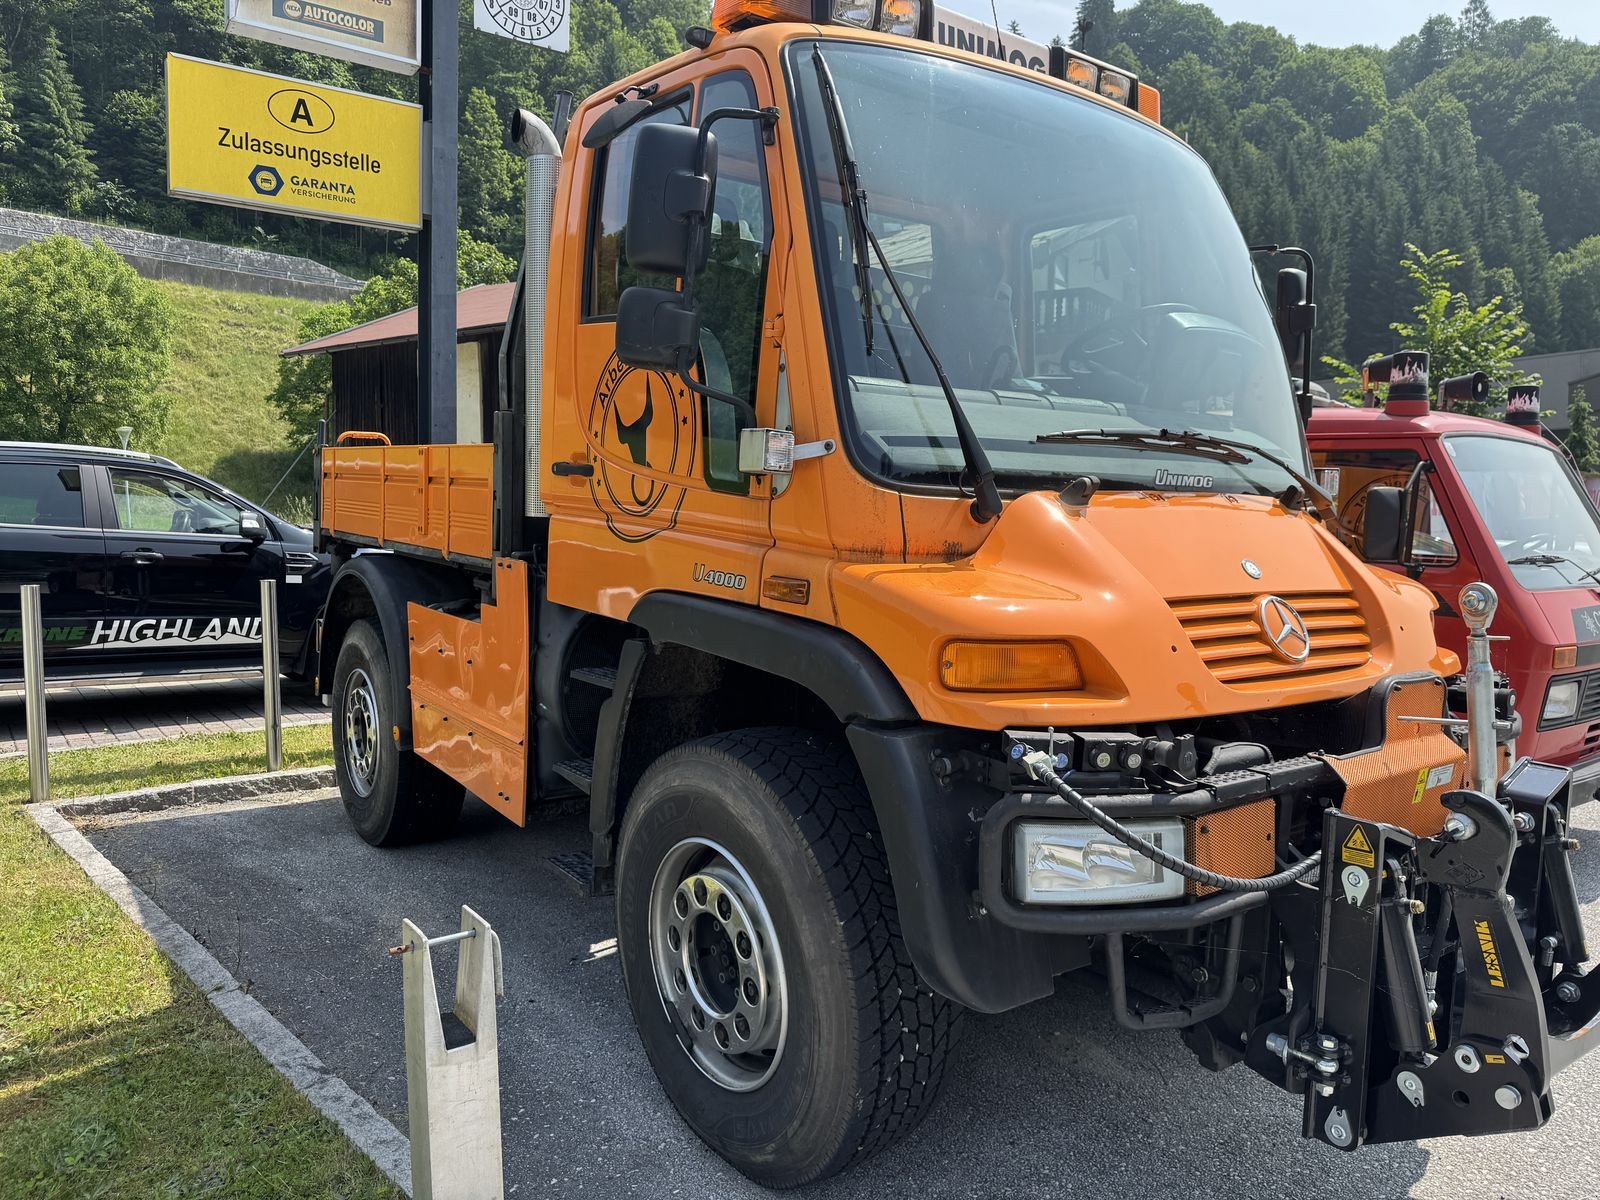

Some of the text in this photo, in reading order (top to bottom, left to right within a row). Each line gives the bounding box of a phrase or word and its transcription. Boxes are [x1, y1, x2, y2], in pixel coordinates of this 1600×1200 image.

[508, 6, 519, 18] 09
[538, 0, 548, 11] 07
[286, 4, 375, 33] NEXA AUTOCOLOR
[527, 11, 537, 23] 08
[520, 27, 526, 36] 6
[536, 26, 542, 36] 5
[290, 98, 314, 127] A
[218, 127, 381, 174] Zulassungsstelle
[290, 175, 356, 195] GARANTA
[290, 187, 356, 204] VERSICHERUNG
[1473, 919, 1505, 988] LESNIK
